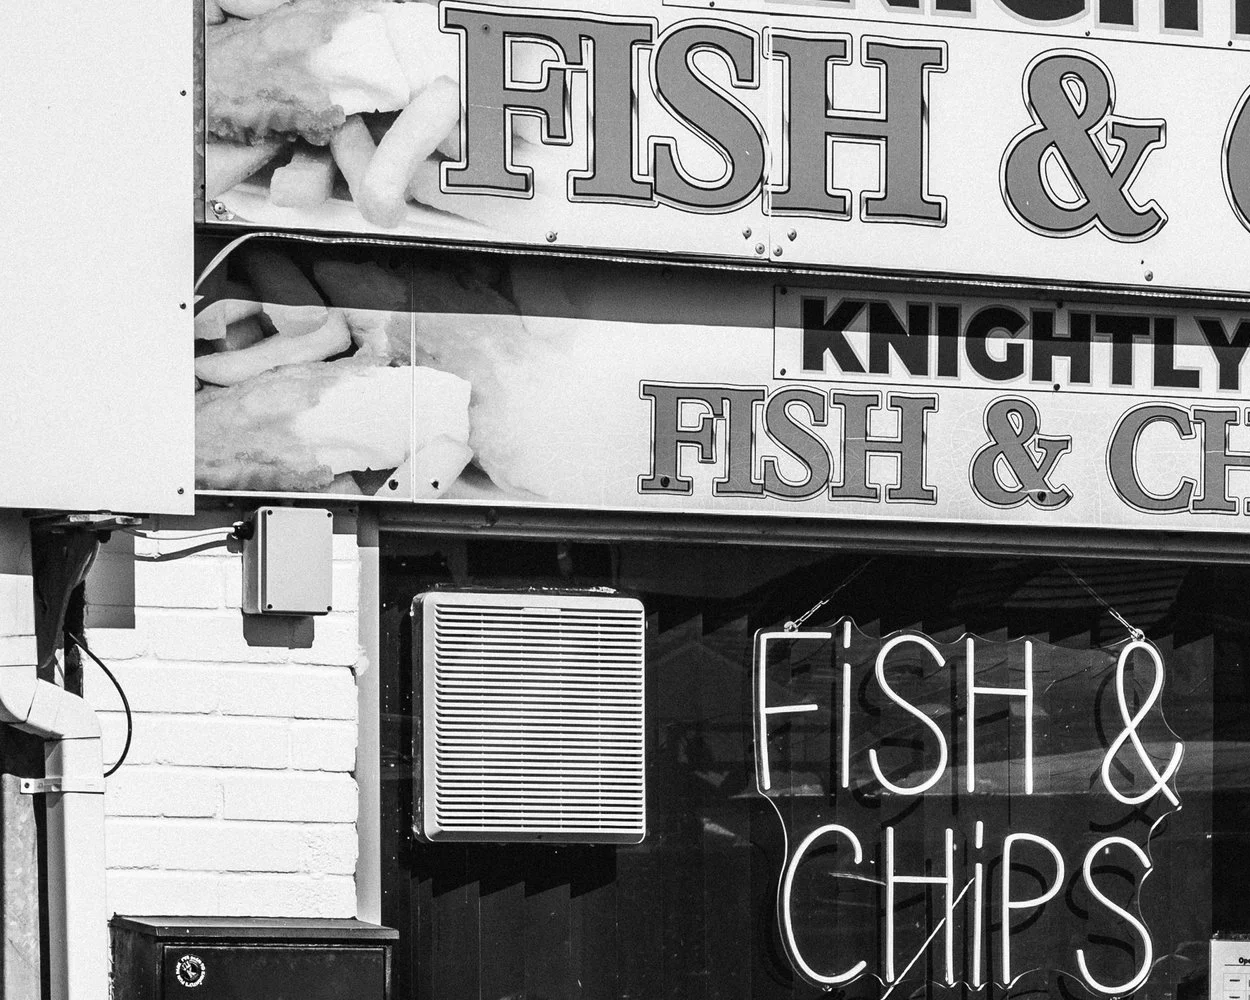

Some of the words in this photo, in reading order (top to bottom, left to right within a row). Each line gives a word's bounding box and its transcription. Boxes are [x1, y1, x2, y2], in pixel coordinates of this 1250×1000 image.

[439, 2, 948, 227] FISH
[999, 48, 1168, 242] &
[637, 380, 939, 505] FISH
[970, 395, 1073, 511] &
[1102, 640, 1184, 807] &
